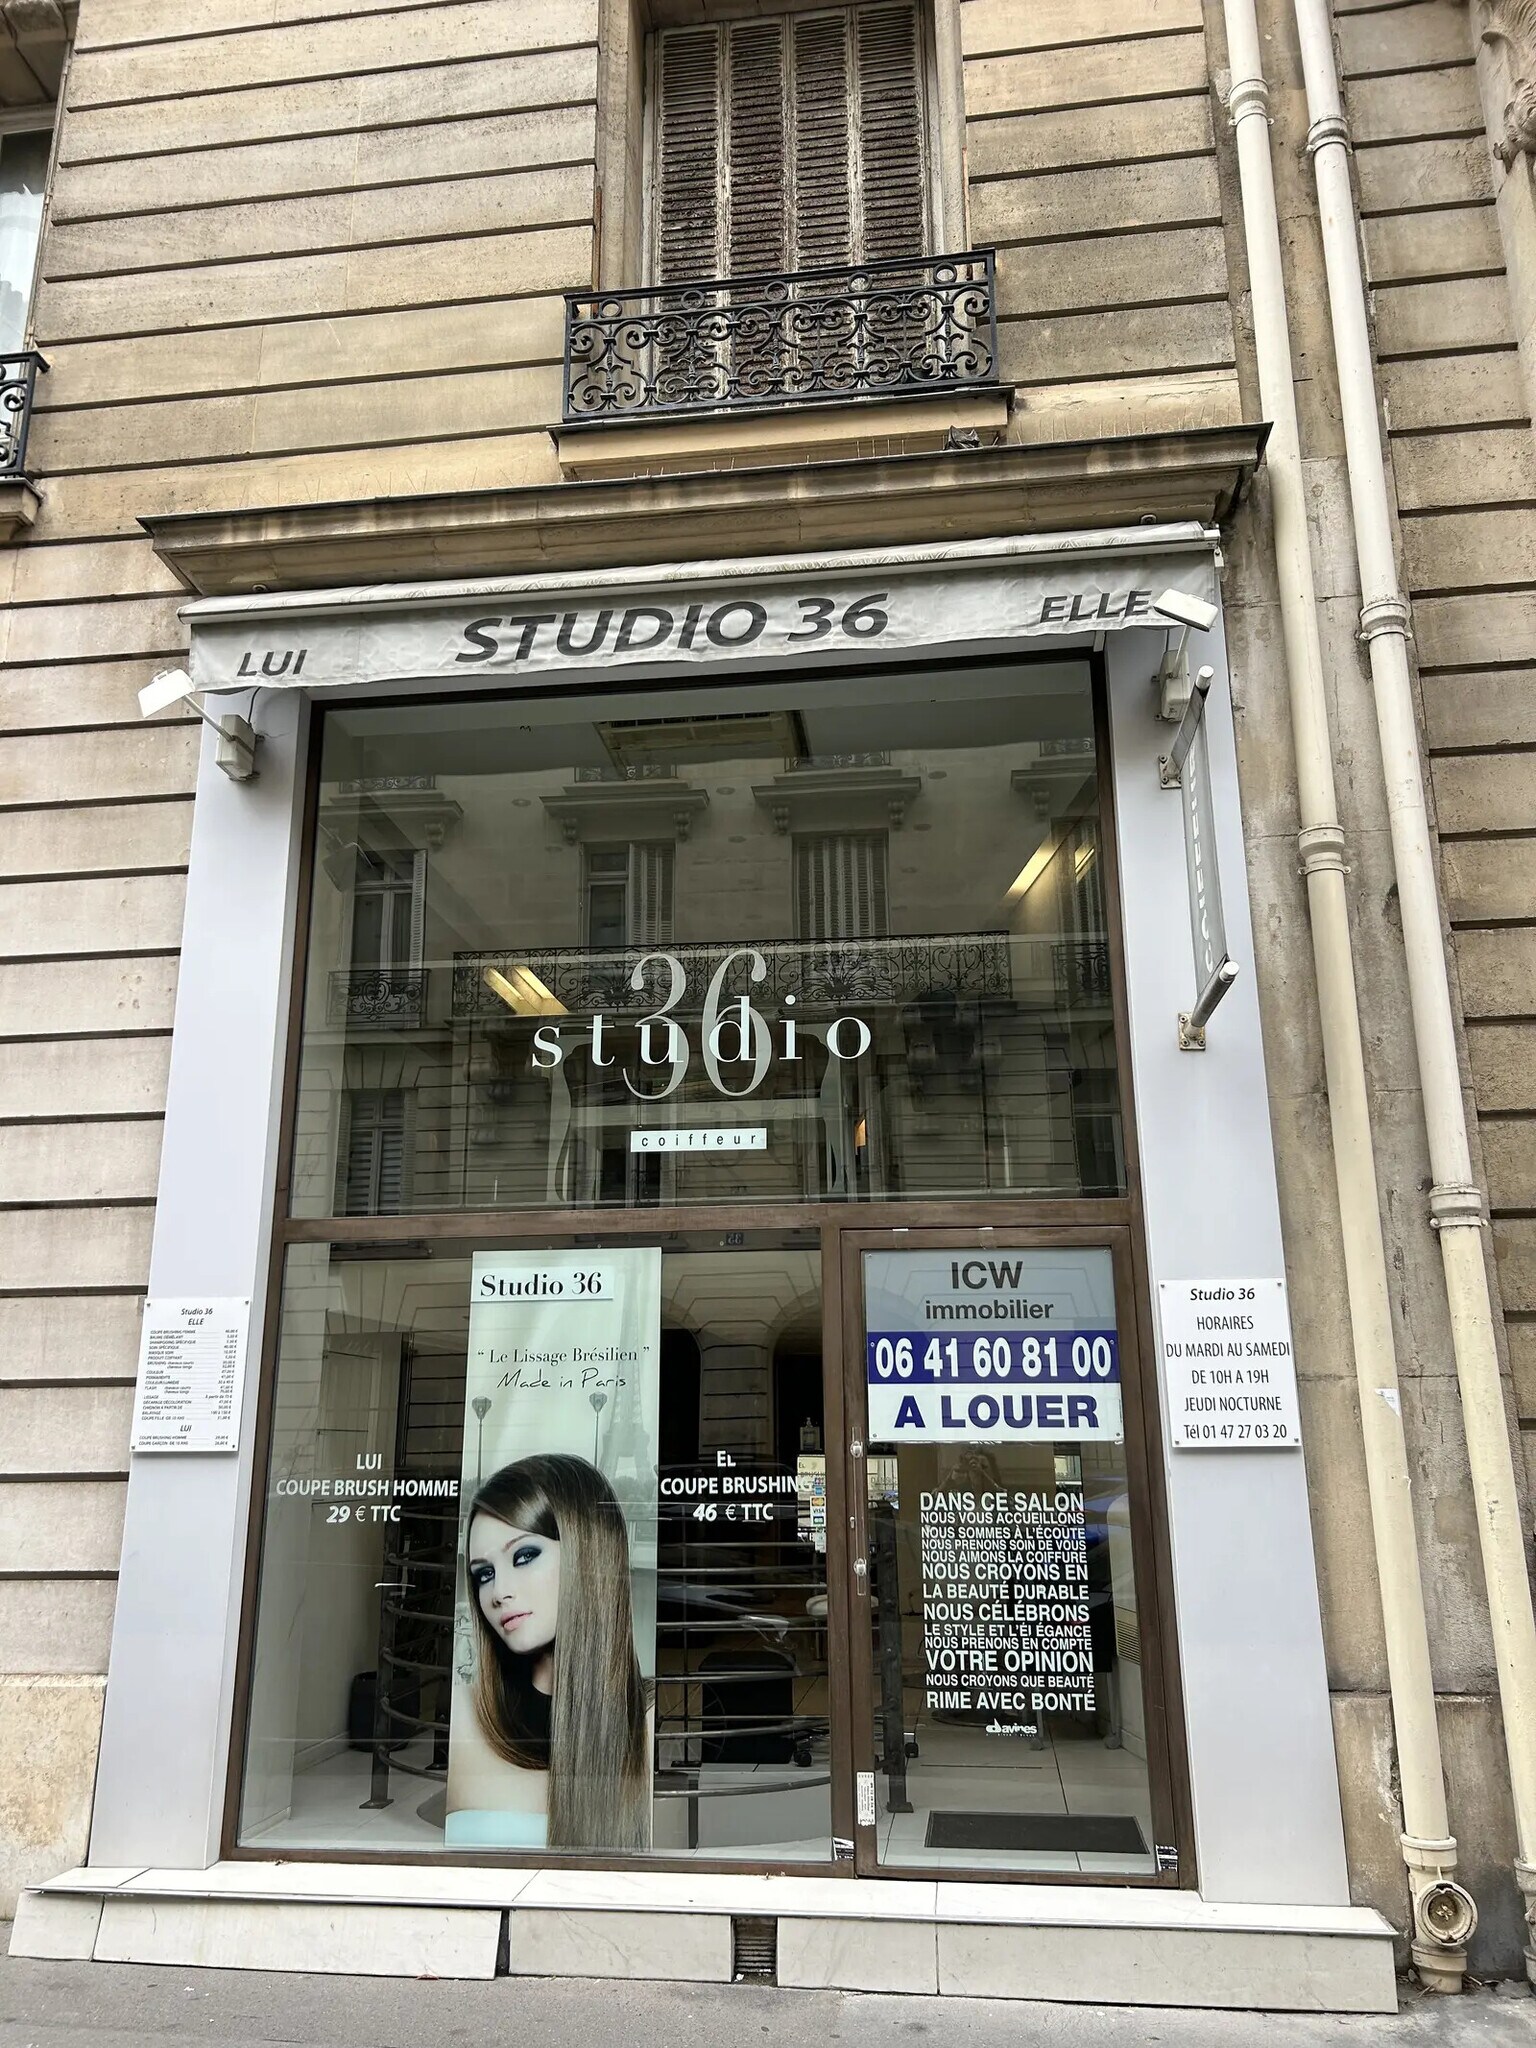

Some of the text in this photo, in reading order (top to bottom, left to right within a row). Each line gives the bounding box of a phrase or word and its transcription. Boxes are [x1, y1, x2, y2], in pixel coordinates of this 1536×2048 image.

[1039, 590, 1152, 624] ELLE
[455, 592, 889, 663] STUDIO 36
[237, 649, 307, 677] LUI
[532, 994, 872, 1068] studio
[622, 950, 772, 1100] 36
[641, 1132, 756, 1147] coiffeur
[480, 1272, 602, 1296] Studio 36
[951, 1261, 1023, 1289] ICW
[1190, 1288, 1255, 1300] Studio 36
[926, 1300, 1053, 1319] immobilier
[1197, 1316, 1254, 1330] HORAIRES
[490, 1350, 508, 1363] Le
[514, 1349, 567, 1366] Lissage
[573, 1347, 637, 1361] Brésilien
[875, 1336, 1112, 1378] 06 41 60 81 00
[1166, 1342, 1290, 1357] DU MARDI AU SAMEDI
[497, 1367, 626, 1389] Made in Paris
[1192, 1370, 1269, 1384] DE 10H A 19H
[894, 1395, 926, 1428] A
[941, 1394, 1099, 1428] LOUER
[1184, 1397, 1282, 1411] JEUDI NOCTURNE
[1184, 1424, 1287, 1439] Tél 01 47 27 03 20
[356, 1454, 382, 1470] LUI
[276, 1480, 458, 1497] COUPE BRUSH HOMME
[660, 1477, 719, 1495] COUPE
[920, 1492, 1084, 1512] DANS CE SALON
[326, 1505, 401, 1523] 29 € TTC
[693, 1503, 774, 1521] 46 € TTC
[920, 1512, 1085, 1525] NOUS VOUS ACCUEILLONS
[921, 1524, 1086, 1539] NOUS SOMMES À L'ÉCOUTE
[921, 1539, 1086, 1550] NOUS PRENONS SOIN DE VOUS
[922, 1551, 1087, 1563] NOUS AIMONS LA COIFFURE
[922, 1563, 1088, 1580] NOUS CROYONS EN
[923, 1581, 1089, 1600] LA BEAUTÉ DURABLE
[924, 1600, 1090, 1622] NOUS CÉLÉBRONS
[924, 1624, 940, 1636] LE
[944, 1624, 985, 1636] STYLE
[989, 1624, 1005, 1636] ET
[925, 1637, 1092, 1650] NOUS PRENONS EN COMPTE
[926, 1650, 1094, 1673] VOTRE OPINION
[926, 1673, 1094, 1688] NOUS CROYONS QUE BEAUTÉ
[927, 1689, 1096, 1711] RIME AVEC BONTÉ
[986, 1718, 1037, 1734] davines
